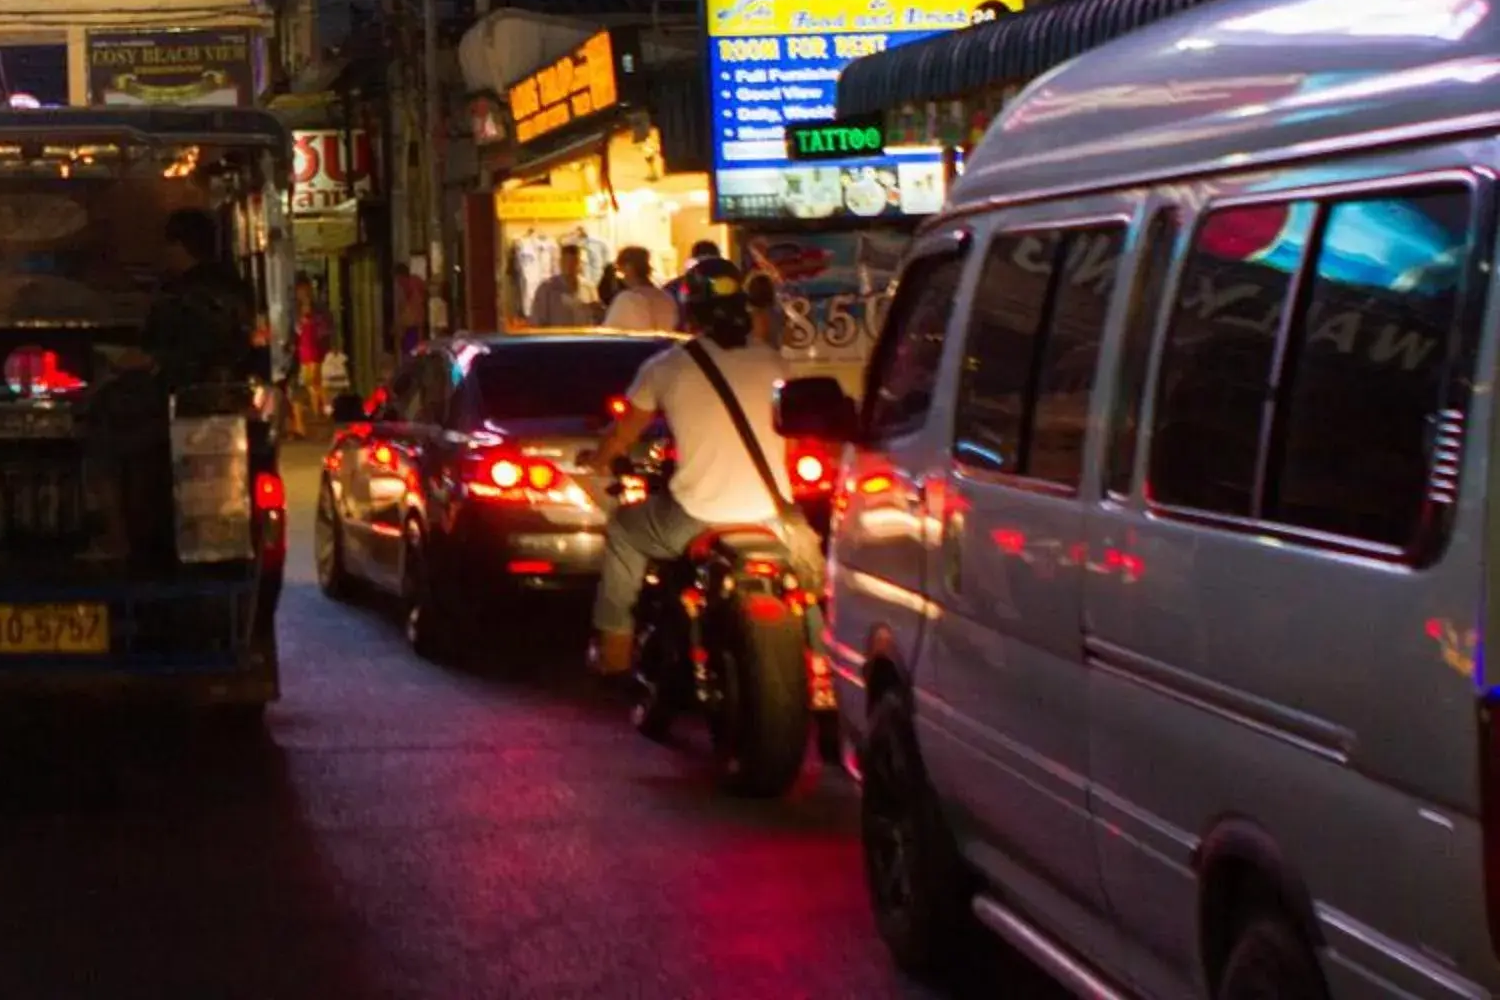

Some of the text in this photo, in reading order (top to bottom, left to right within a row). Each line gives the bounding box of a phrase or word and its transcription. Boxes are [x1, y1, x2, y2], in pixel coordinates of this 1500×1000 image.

[717, 37, 780, 62] ROOM
[786, 34, 829, 60] FOR
[795, 126, 882, 153] TATTOO
